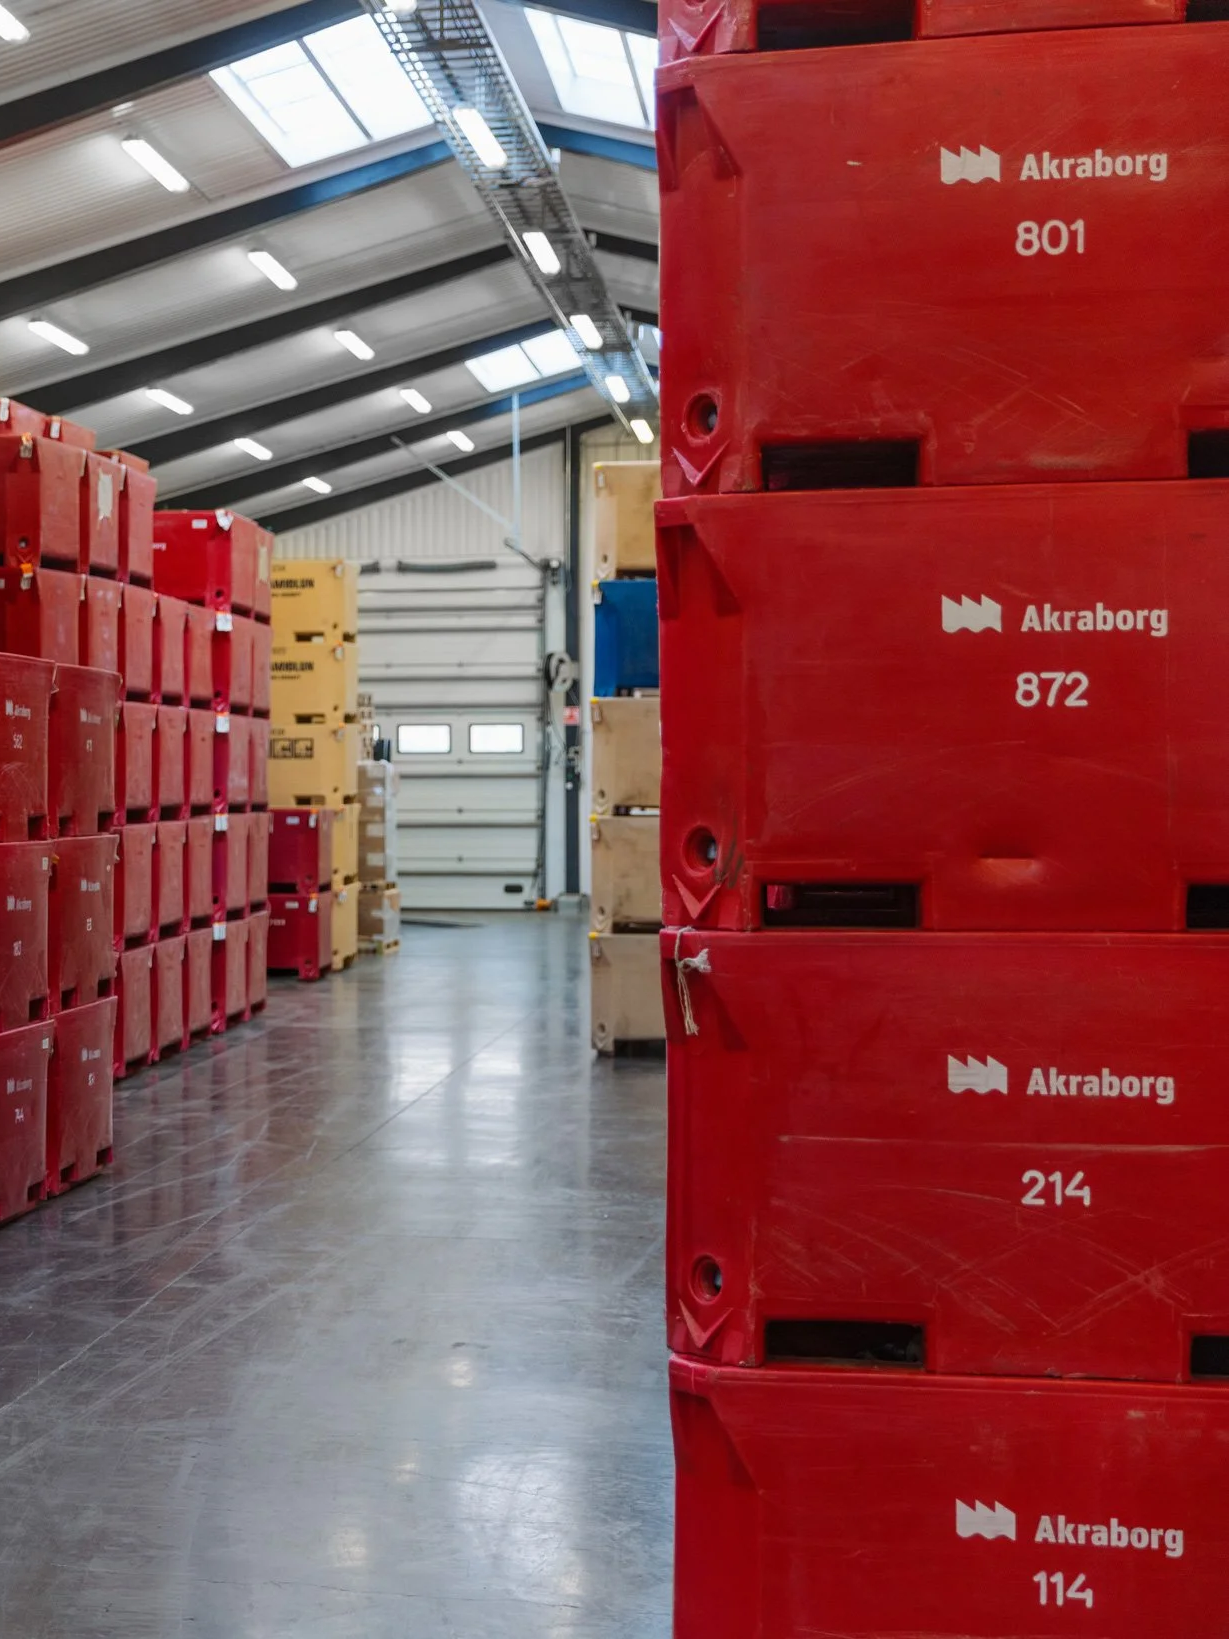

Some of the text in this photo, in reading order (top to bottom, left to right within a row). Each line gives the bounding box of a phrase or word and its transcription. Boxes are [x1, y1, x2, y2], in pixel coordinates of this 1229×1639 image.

[1019, 148, 1168, 182] Akraborg
[1015, 218, 1085, 257] 801
[1020, 602, 1169, 638] Akraborg
[1015, 671, 1089, 708] 872
[1026, 1066, 1175, 1105] Akraborg
[1021, 1169, 1091, 1207] 214
[1034, 1514, 1184, 1558] Akraborg
[1032, 1570, 1094, 1609] 114
